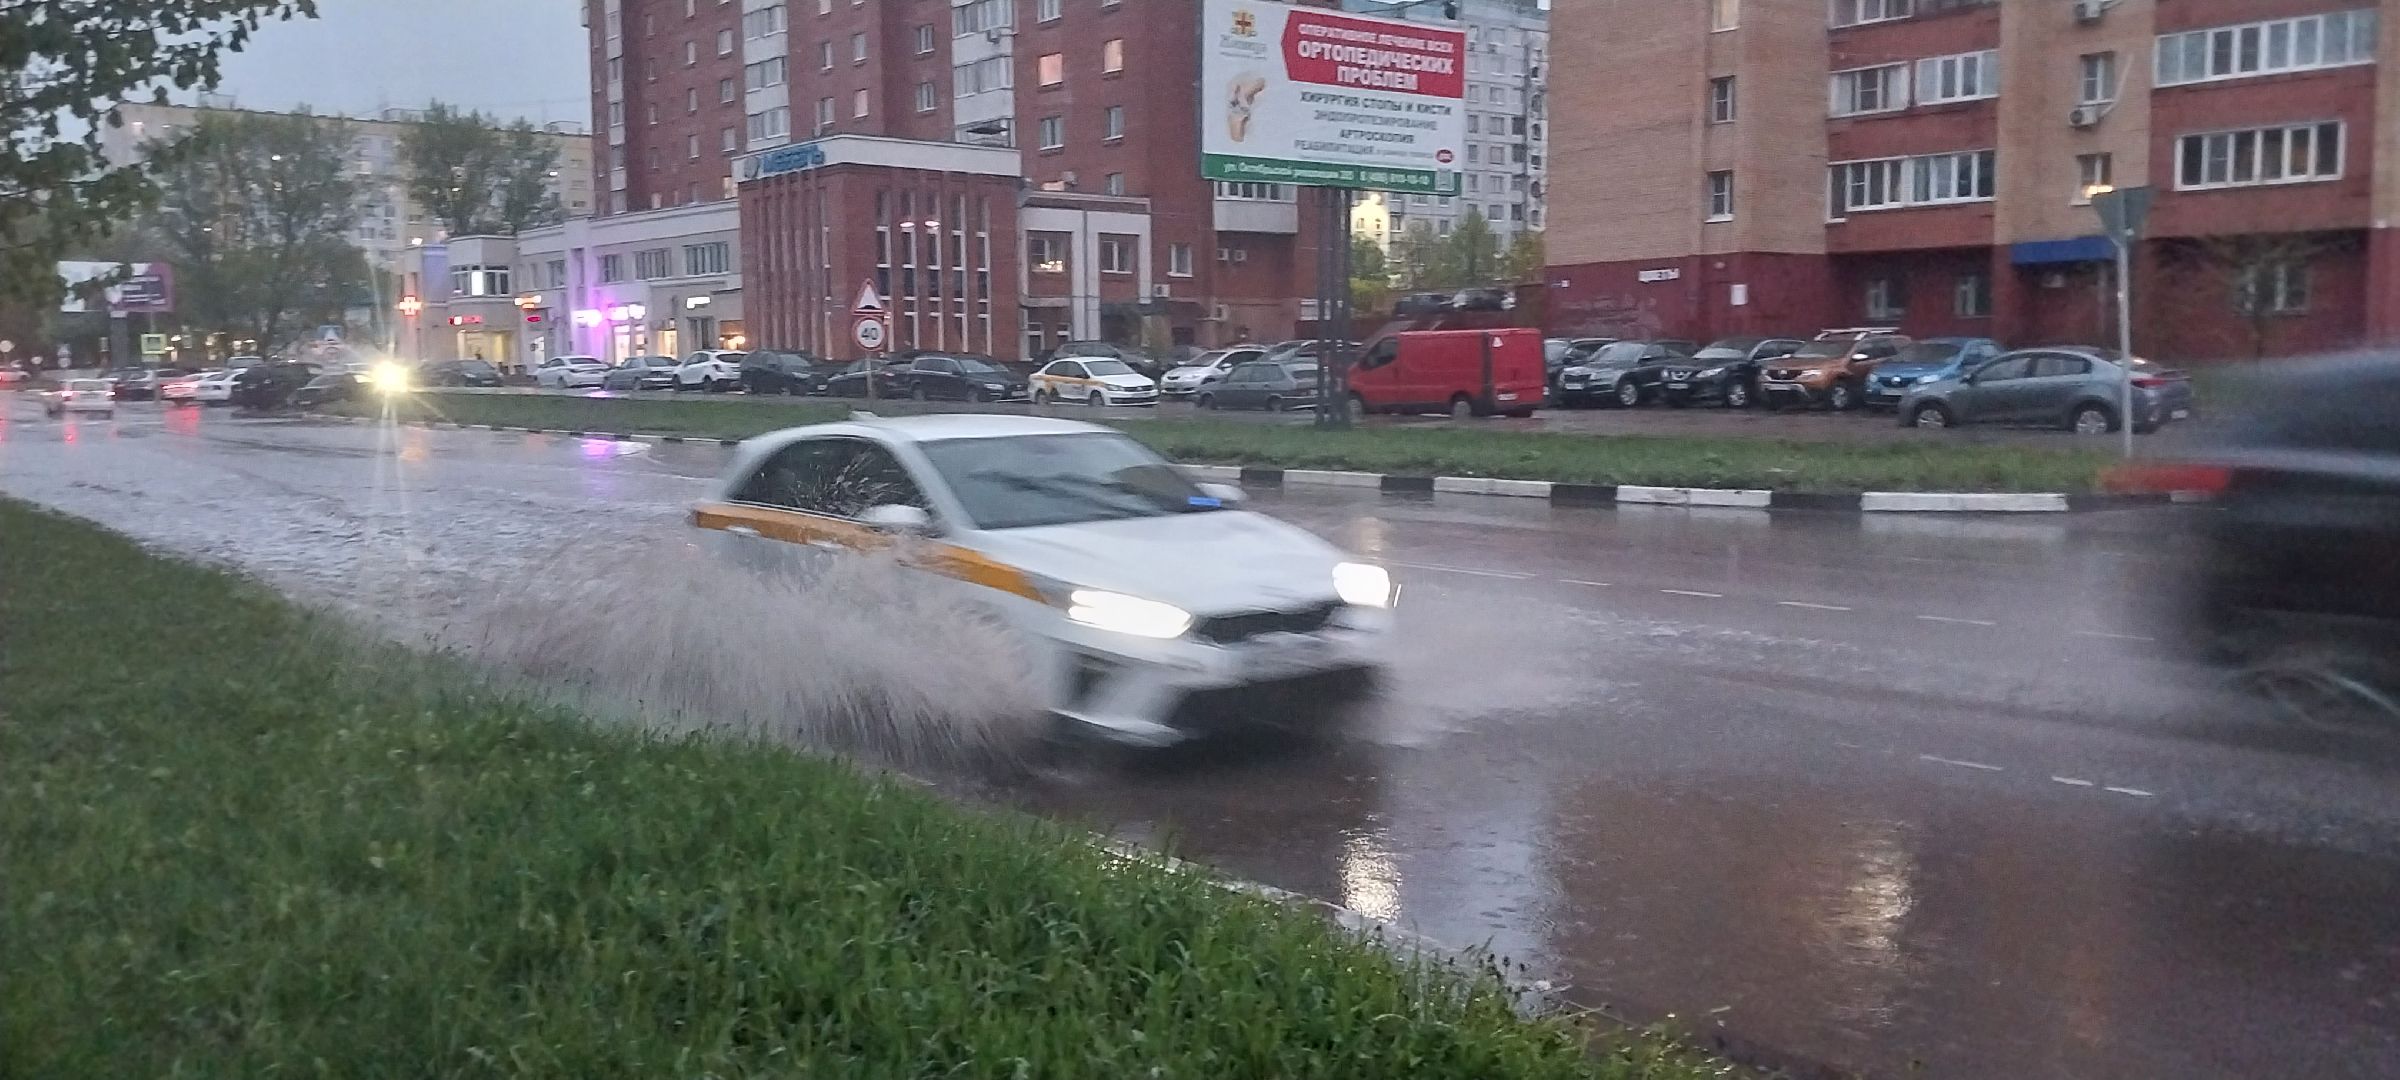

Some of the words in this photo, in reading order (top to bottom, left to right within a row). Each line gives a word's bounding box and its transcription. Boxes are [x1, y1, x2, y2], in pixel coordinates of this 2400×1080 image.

[1298, 23, 1377, 42] ОПЕРАТИВНОЕ
[1378, 34, 1426, 50] ЛЕЧЕНИЕ
[1427, 40, 1454, 53] ВСЕХ
[1298, 40, 1454, 75] ОРТОПЕДИЧЕСКИХ
[1337, 65, 1418, 90] ПРОБЛЕМ
[1301, 91, 1360, 107] ХИРУРГИЯ
[1363, 98, 1401, 112] СТОПЫ
[1405, 102, 1413, 112] И
[1416, 103, 1452, 115] КИСТИ
[1314, 109, 1438, 131] ЭНДОПРОТЕЗИРОВАНИЕ
[1294, 139, 1374, 155] РЕАБИЛИТАЦИЯ
[1340, 129, 1415, 144] АРТРОСКОПИЯ
[861, 327, 878, 340] 40
